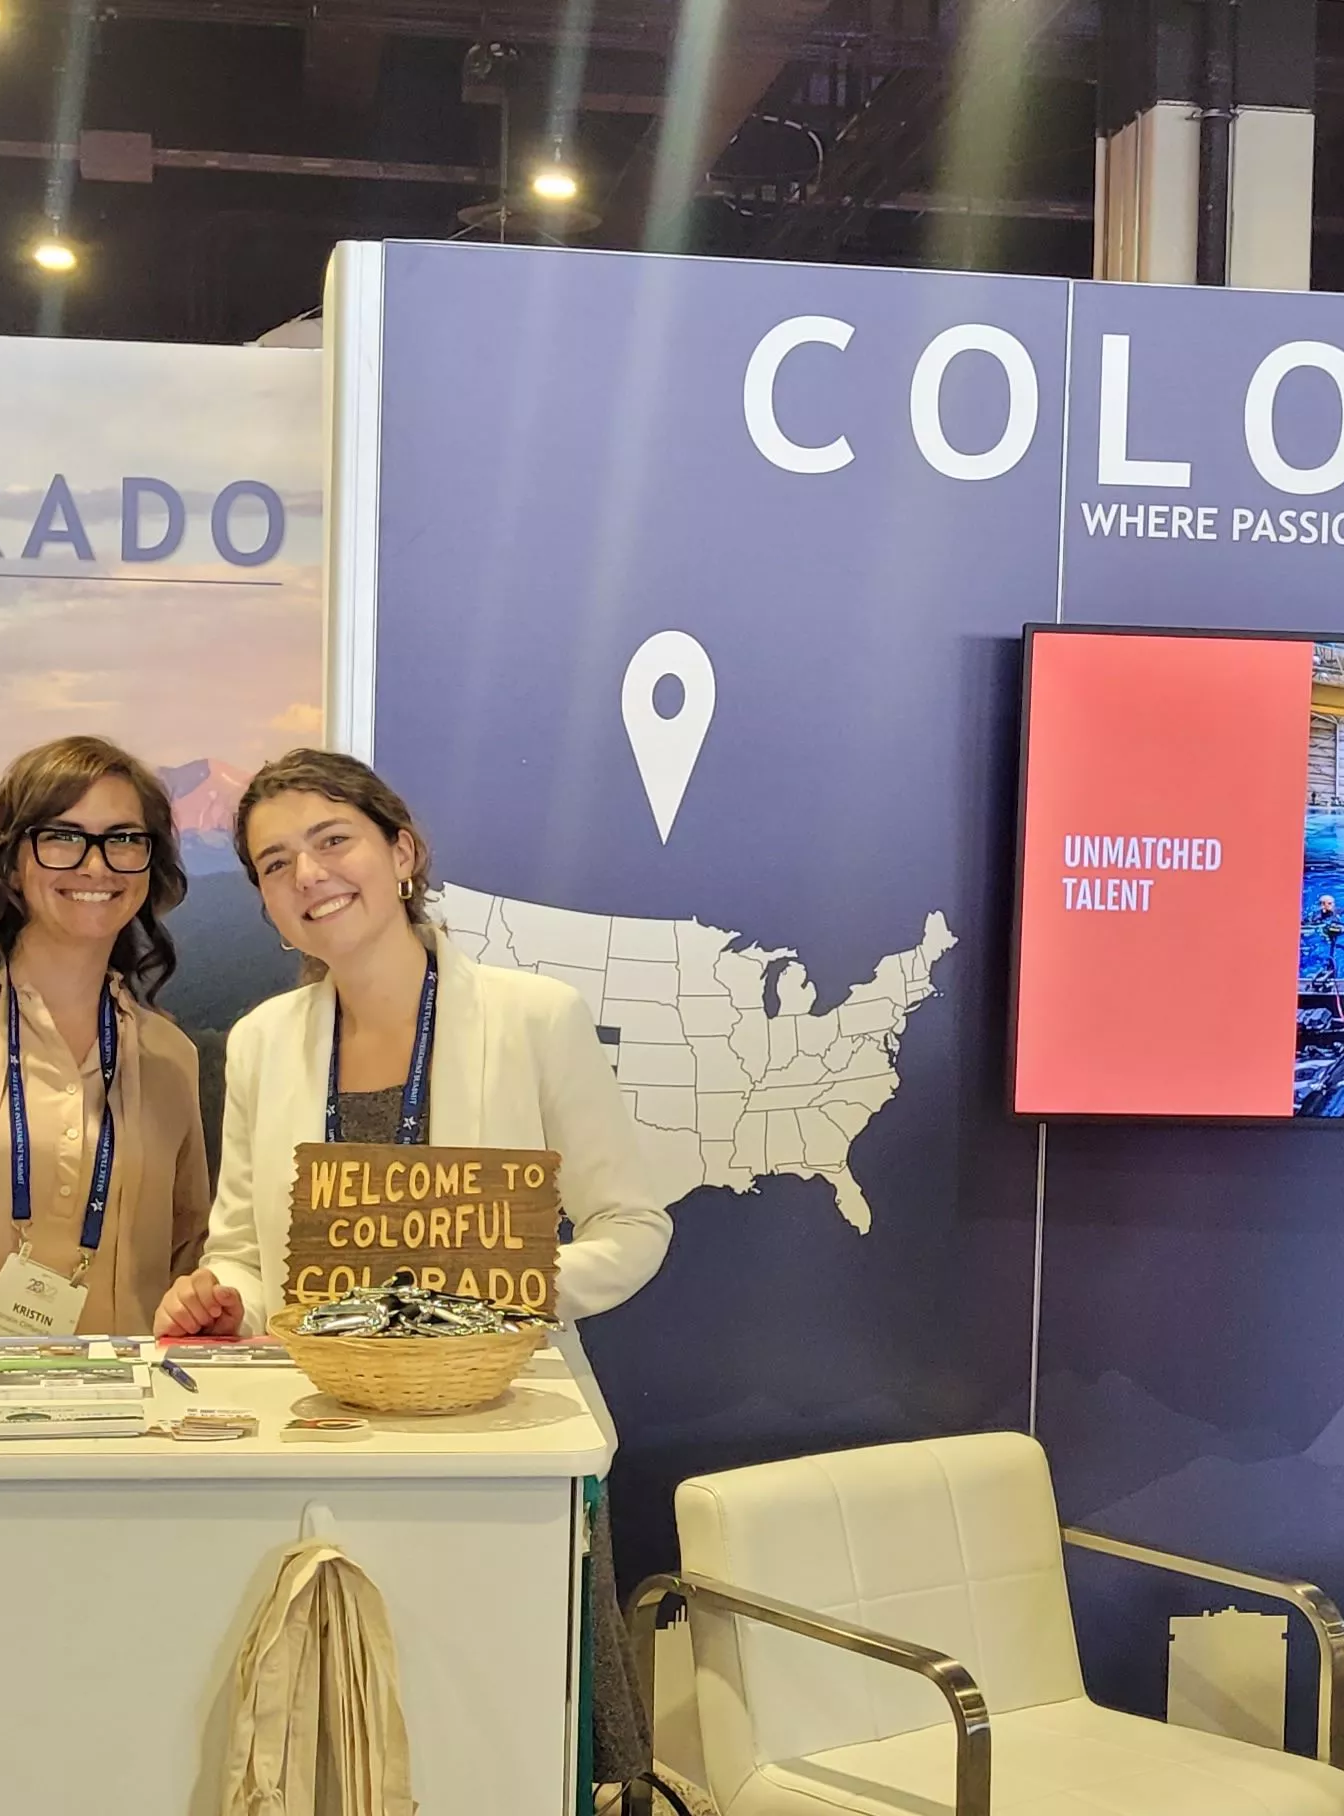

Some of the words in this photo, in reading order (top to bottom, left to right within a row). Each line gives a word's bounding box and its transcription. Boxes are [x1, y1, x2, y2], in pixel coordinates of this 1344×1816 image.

[1081, 502, 1218, 541] WHERE
[1064, 834, 1221, 872] UNMATCHED
[1062, 877, 1154, 913] TALENT
[310, 1161, 483, 1209] WELCOME
[502, 1162, 545, 1190] TO
[328, 1201, 525, 1249] COLORFUL
[12, 1302, 53, 1326] KRISTIN
